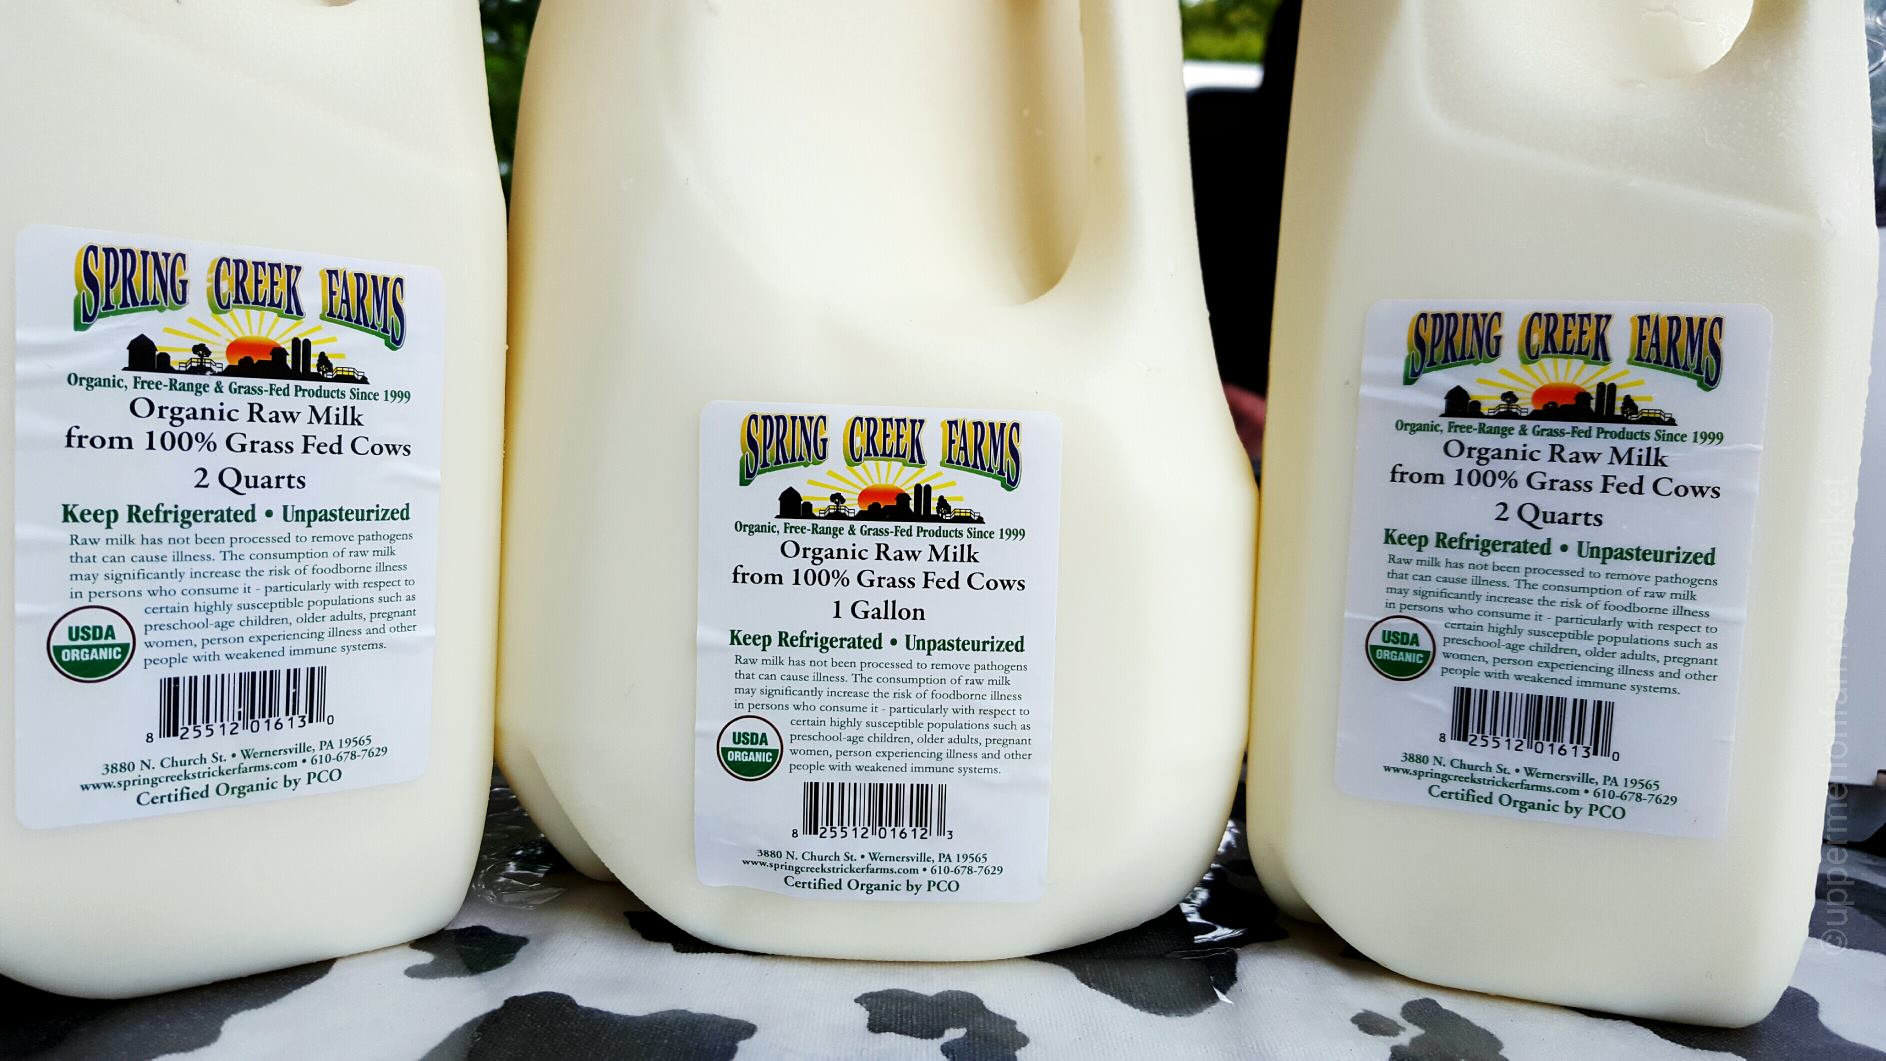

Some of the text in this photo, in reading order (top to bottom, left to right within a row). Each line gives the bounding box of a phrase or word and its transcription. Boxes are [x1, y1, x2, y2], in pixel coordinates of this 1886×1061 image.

[73, 242, 406, 351] SPRING CREEK FARMS
[1403, 311, 1724, 393] SPRING CREEK FARMS
[66, 372, 411, 404] Organic, Free-Range & Grass-Fed Products Since 1999
[129, 396, 365, 428] Organic Raw Milk
[64, 425, 411, 457] from 100% Grass Fed Cows
[1395, 419, 1724, 446] Organic, Free-Range & Grass-Fed Products Since 1999
[739, 413, 1022, 492] SPRING CREEK FARMS
[1443, 439, 1669, 468] Organic Raw Milk
[194, 466, 306, 496] 2 Quarts
[1389, 463, 1721, 499] from 100% Grass Fed Cows
[61, 502, 411, 530] Keep Refrigerated Unpasteurized
[1494, 502, 1603, 530] 2 Quarts
[69, 530, 413, 548] Raw milk has not been processed to remove pathogens
[734, 520, 1026, 541] Organic, Free-Range & Grass-Fed Products Since 1999
[780, 539, 980, 566] Organic Raw Milk
[1383, 528, 1716, 566] Keep Refrigerated Unpasteurized
[731, 564, 1026, 591] from 100% Grass Fed Cows
[832, 599, 926, 621] 1 Gallon
[67, 625, 116, 642] USDA
[728, 629, 1025, 657] Keep Refrigerated Unpasteurized
[1382, 630, 1420, 647] USDA
[61, 647, 122, 662] ORGANIC
[1376, 649, 1424, 664] ORGANIC
[1443, 636, 1718, 668] preschool-age children, older adults, pregnant
[734, 685, 1022, 701] may significantly increase the risk of foodborne illness
[732, 732, 769, 746] USDA
[80, 746, 388, 791] www.springcreekstrickerfarms.com 610-678-7629
[101, 734, 372, 776] 3880 N. Church St. Wernersville, PA 19565
[727, 751, 772, 763] ORGANIC
[1383, 765, 1678, 806] www.springcreekstrickerfarms.com 610-678-7629
[1400, 752, 1660, 792] 3880 N. Church St. Wernersville, PA 19565
[136, 768, 343, 806] Certified Organic by PCO
[1428, 784, 1626, 820] Certified Organic by PCO
[741, 860, 1003, 876] www.springcreekstrickerfarms.com 610-678-7629
[757, 849, 988, 864] 3880 N. Church St. Wernersville, PA 19565
[784, 875, 960, 896] Certified Organic by PCO
